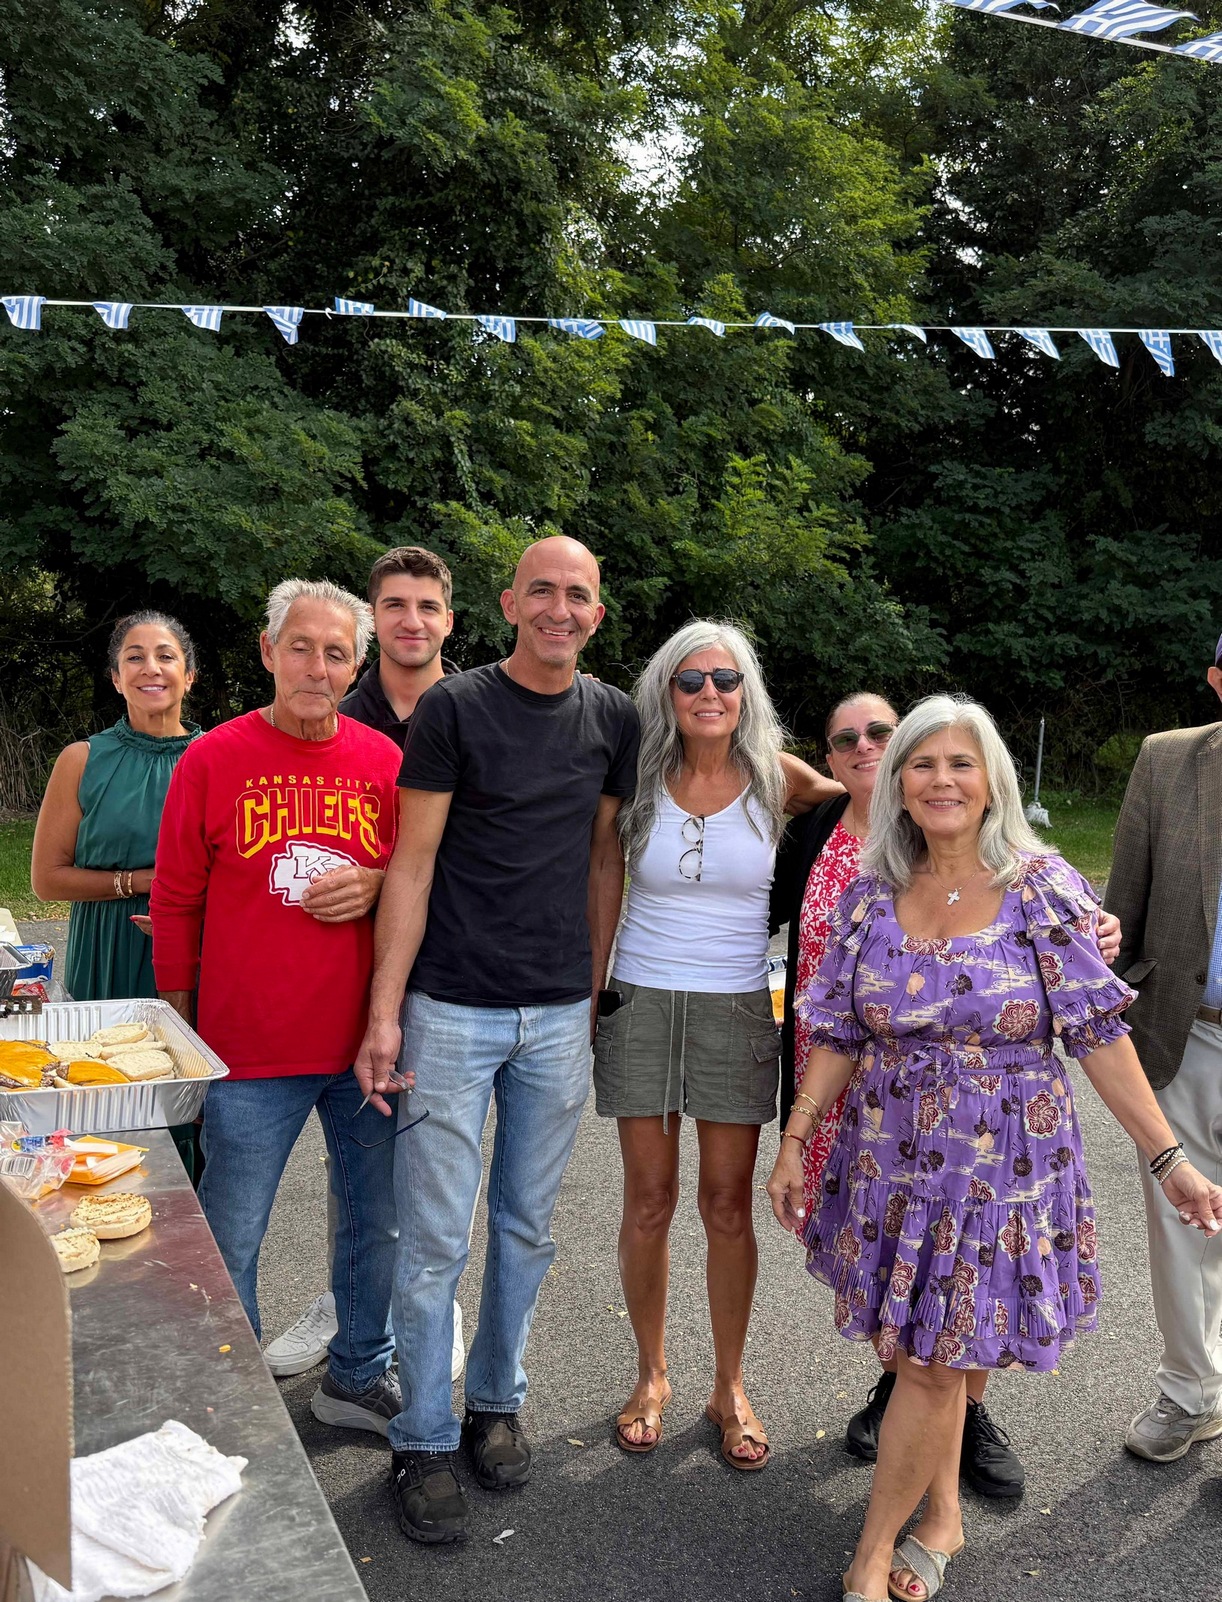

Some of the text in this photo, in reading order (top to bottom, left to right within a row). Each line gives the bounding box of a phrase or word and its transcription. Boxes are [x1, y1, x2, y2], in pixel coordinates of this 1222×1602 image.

[245, 775, 373, 791] KANSAS CITY
[235, 787, 382, 859] CHIEFS
